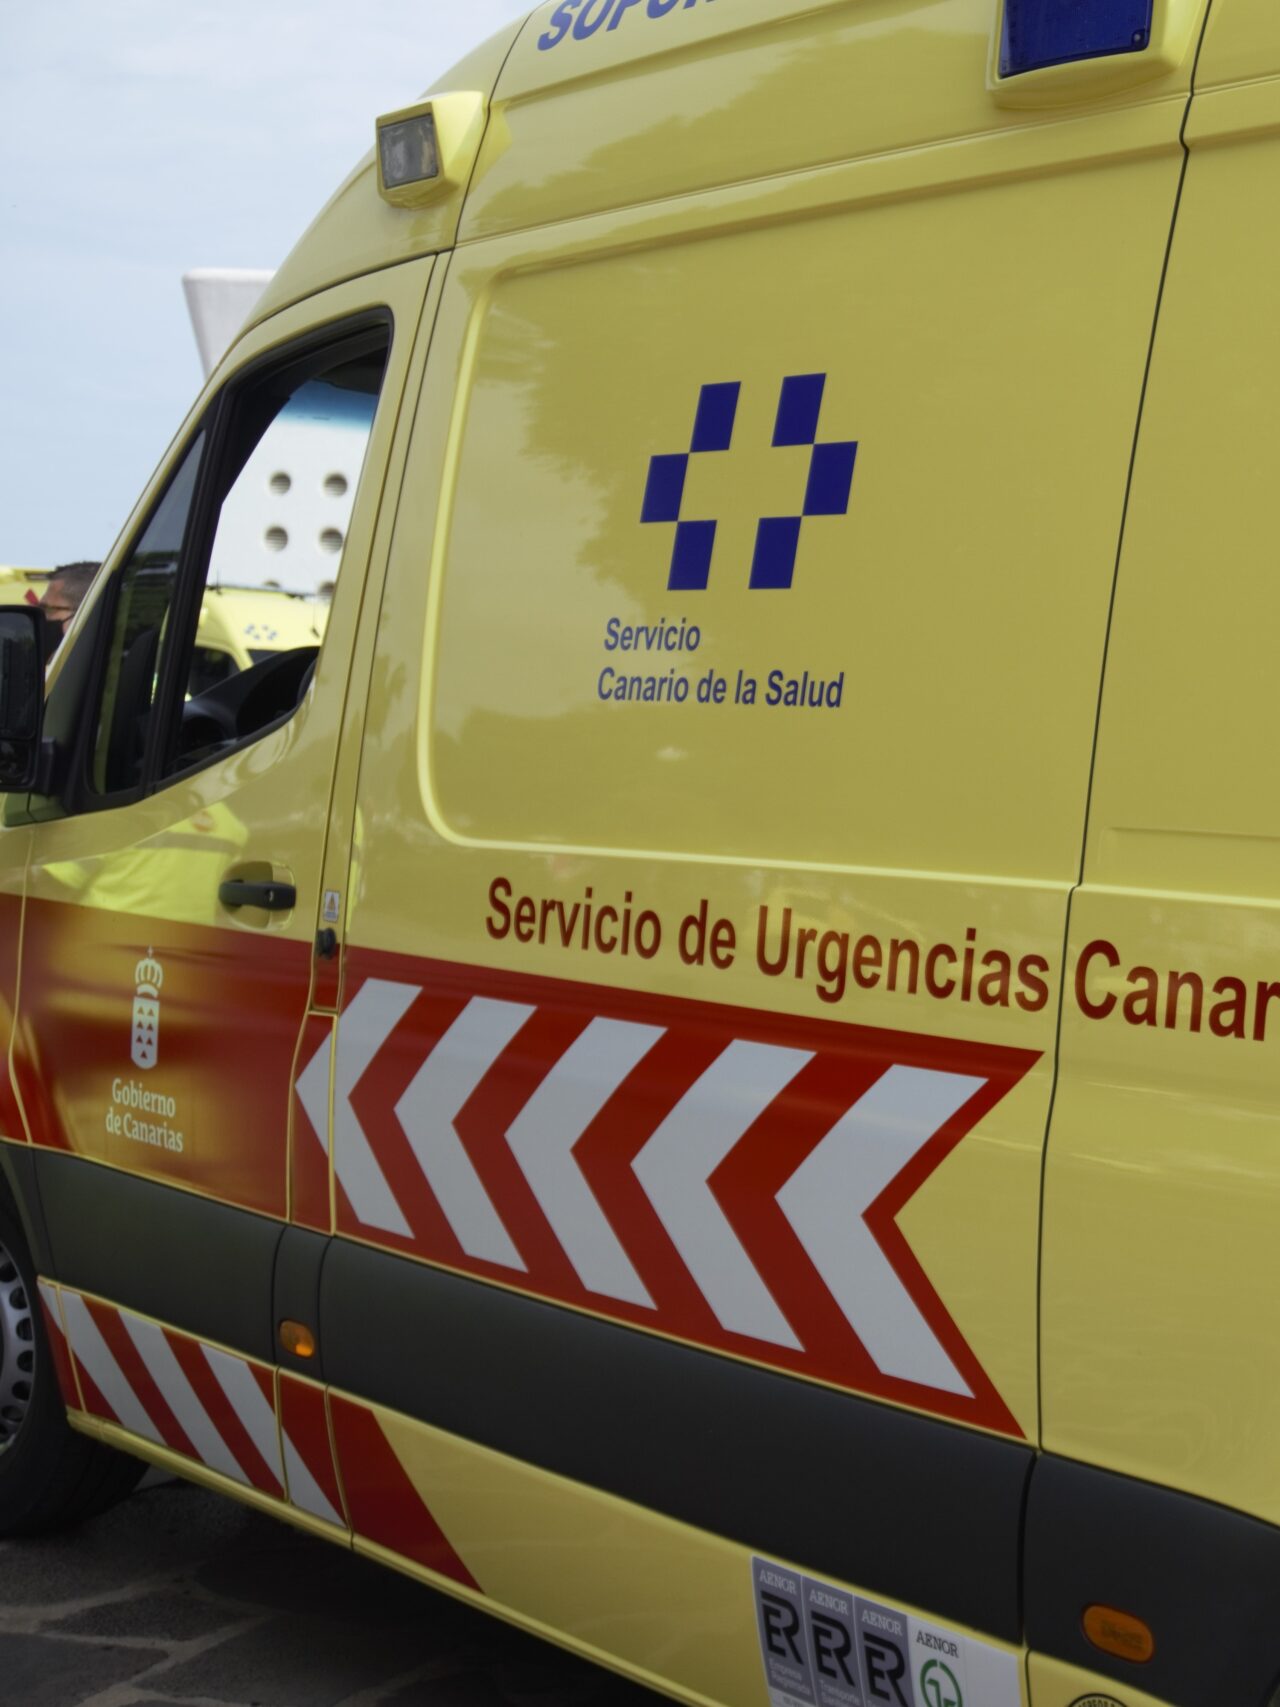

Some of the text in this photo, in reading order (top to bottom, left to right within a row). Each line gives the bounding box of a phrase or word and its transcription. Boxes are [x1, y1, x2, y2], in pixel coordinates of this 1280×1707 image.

[604, 617, 701, 651] Servicio
[597, 667, 845, 708] Canario de la Salud
[486, 877, 662, 960] Servicio
[678, 900, 736, 969] de
[756, 904, 1050, 1013] Urgencias
[112, 1077, 176, 1118] Gobierno
[105, 1107, 183, 1153] de Canarias
[760, 1569, 797, 1595] AENOR
[809, 1589, 848, 1616] AENOR
[862, 1609, 902, 1637] AENOR
[916, 1629, 960, 1659] AENOR
